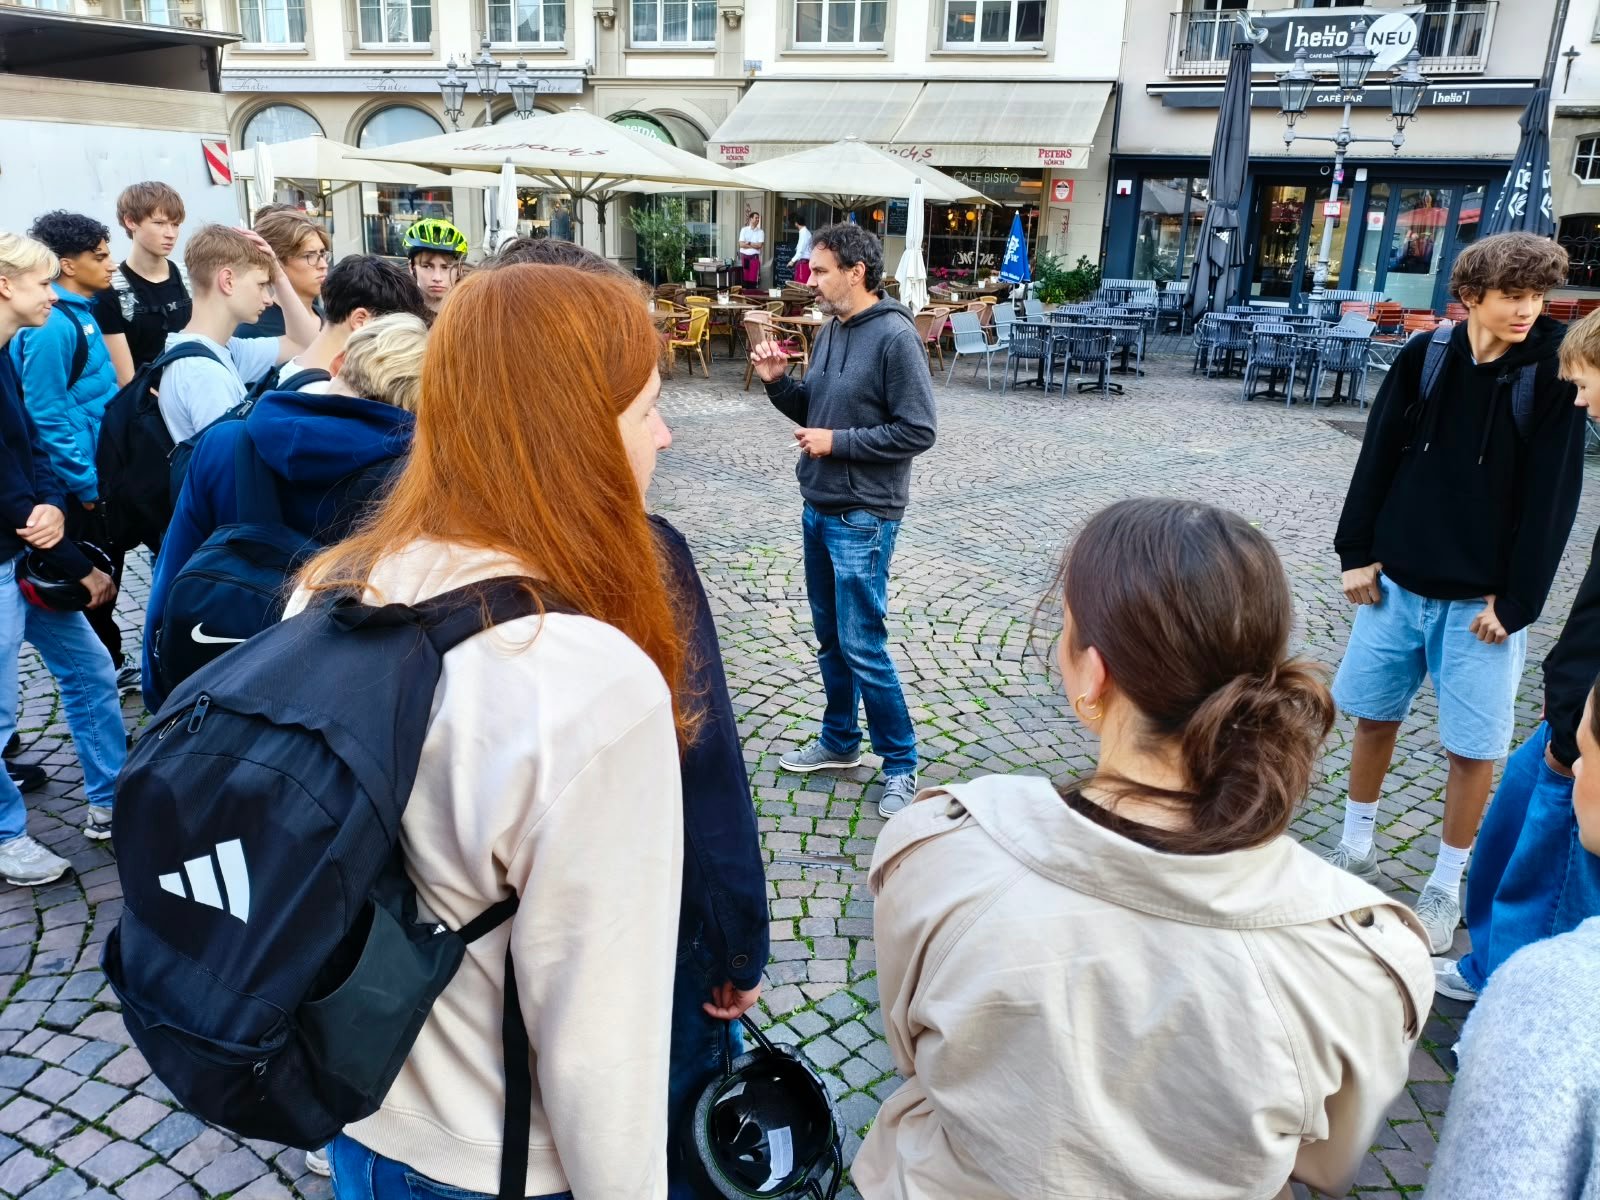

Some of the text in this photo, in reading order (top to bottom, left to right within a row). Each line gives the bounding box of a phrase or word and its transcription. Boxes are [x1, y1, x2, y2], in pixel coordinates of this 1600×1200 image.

[1370, 31, 1412, 46] NEU
[720, 145, 750, 154] PETERS
[1038, 148, 1073, 159] PETERS
[984, 172, 1020, 184] BISTRO
